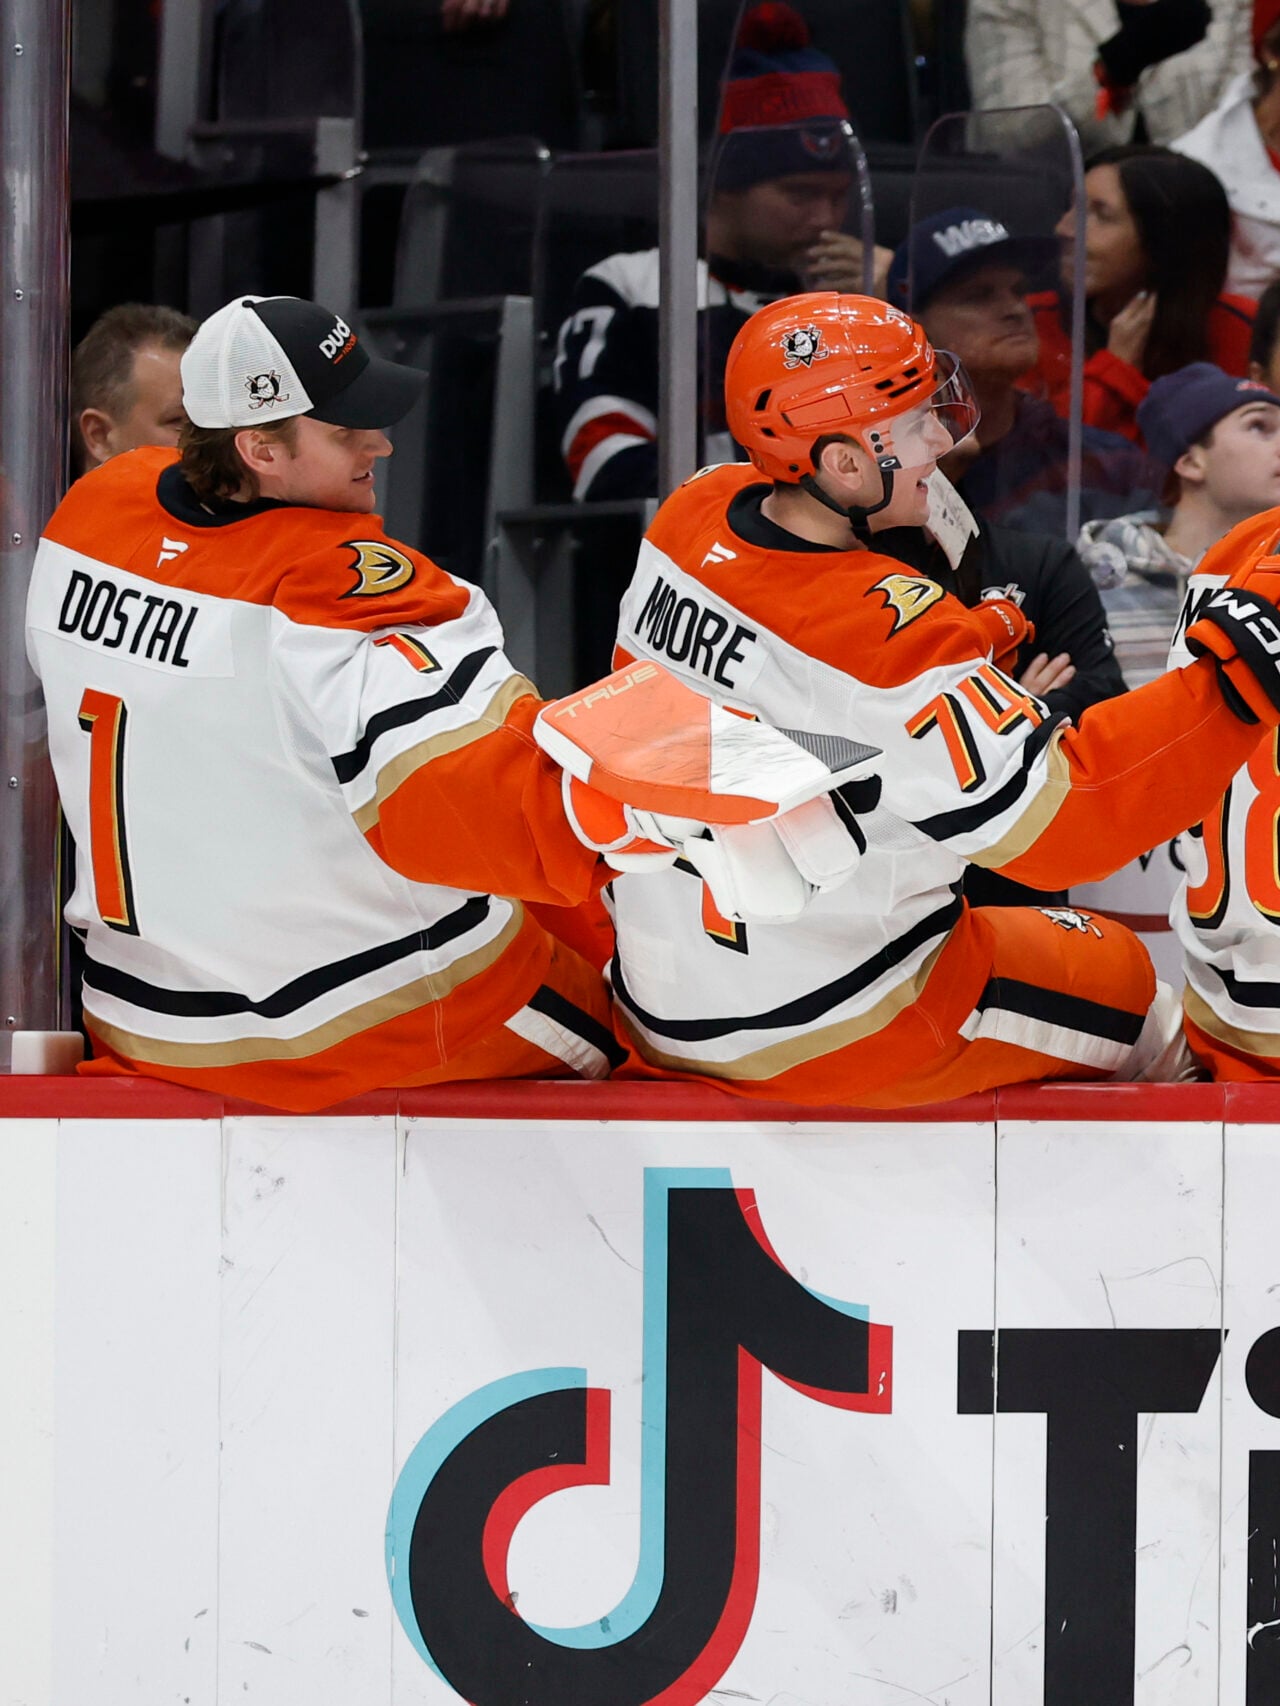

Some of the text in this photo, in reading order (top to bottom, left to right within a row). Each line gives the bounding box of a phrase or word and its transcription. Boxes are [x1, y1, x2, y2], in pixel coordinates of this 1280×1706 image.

[58, 570, 198, 668] DOSTAL
[373, 631, 443, 675] 1
[634, 576, 757, 690] MOORE
[554, 664, 659, 719] TRUE
[905, 664, 1049, 793] 74
[78, 687, 142, 937] 1
